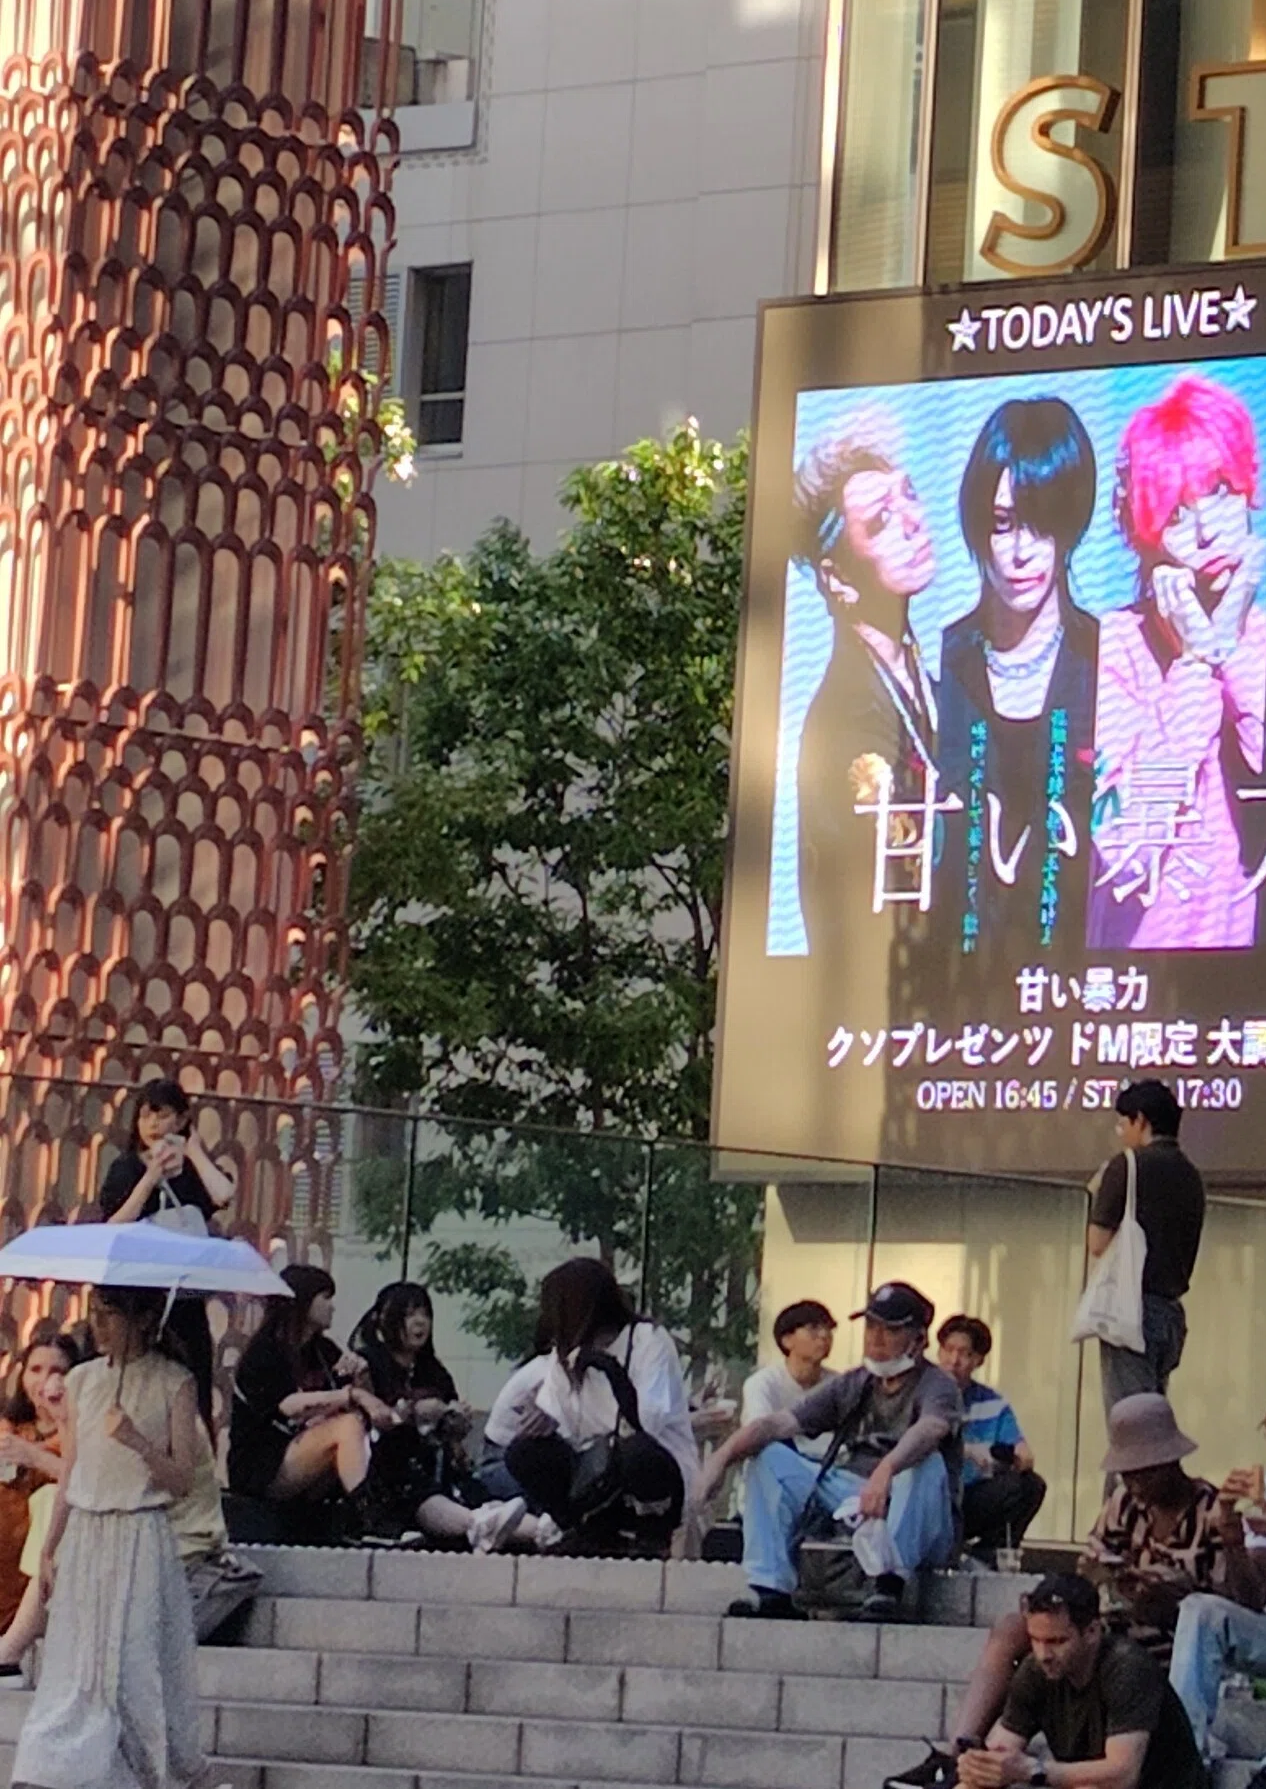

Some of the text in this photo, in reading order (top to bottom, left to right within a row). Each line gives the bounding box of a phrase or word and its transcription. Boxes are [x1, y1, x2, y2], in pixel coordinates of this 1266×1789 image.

[981, 289, 1223, 351] TODAY'S LIVE
[1015, 965, 1148, 1013] 甘い暴力
[827, 1022, 1053, 1068] クソプレゼンツ
[1071, 1019, 1198, 1069] ドM限定
[916, 1079, 987, 1110] OPEN
[993, 1078, 1058, 1110] 16:45
[1177, 1077, 1243, 1109] 17:30
